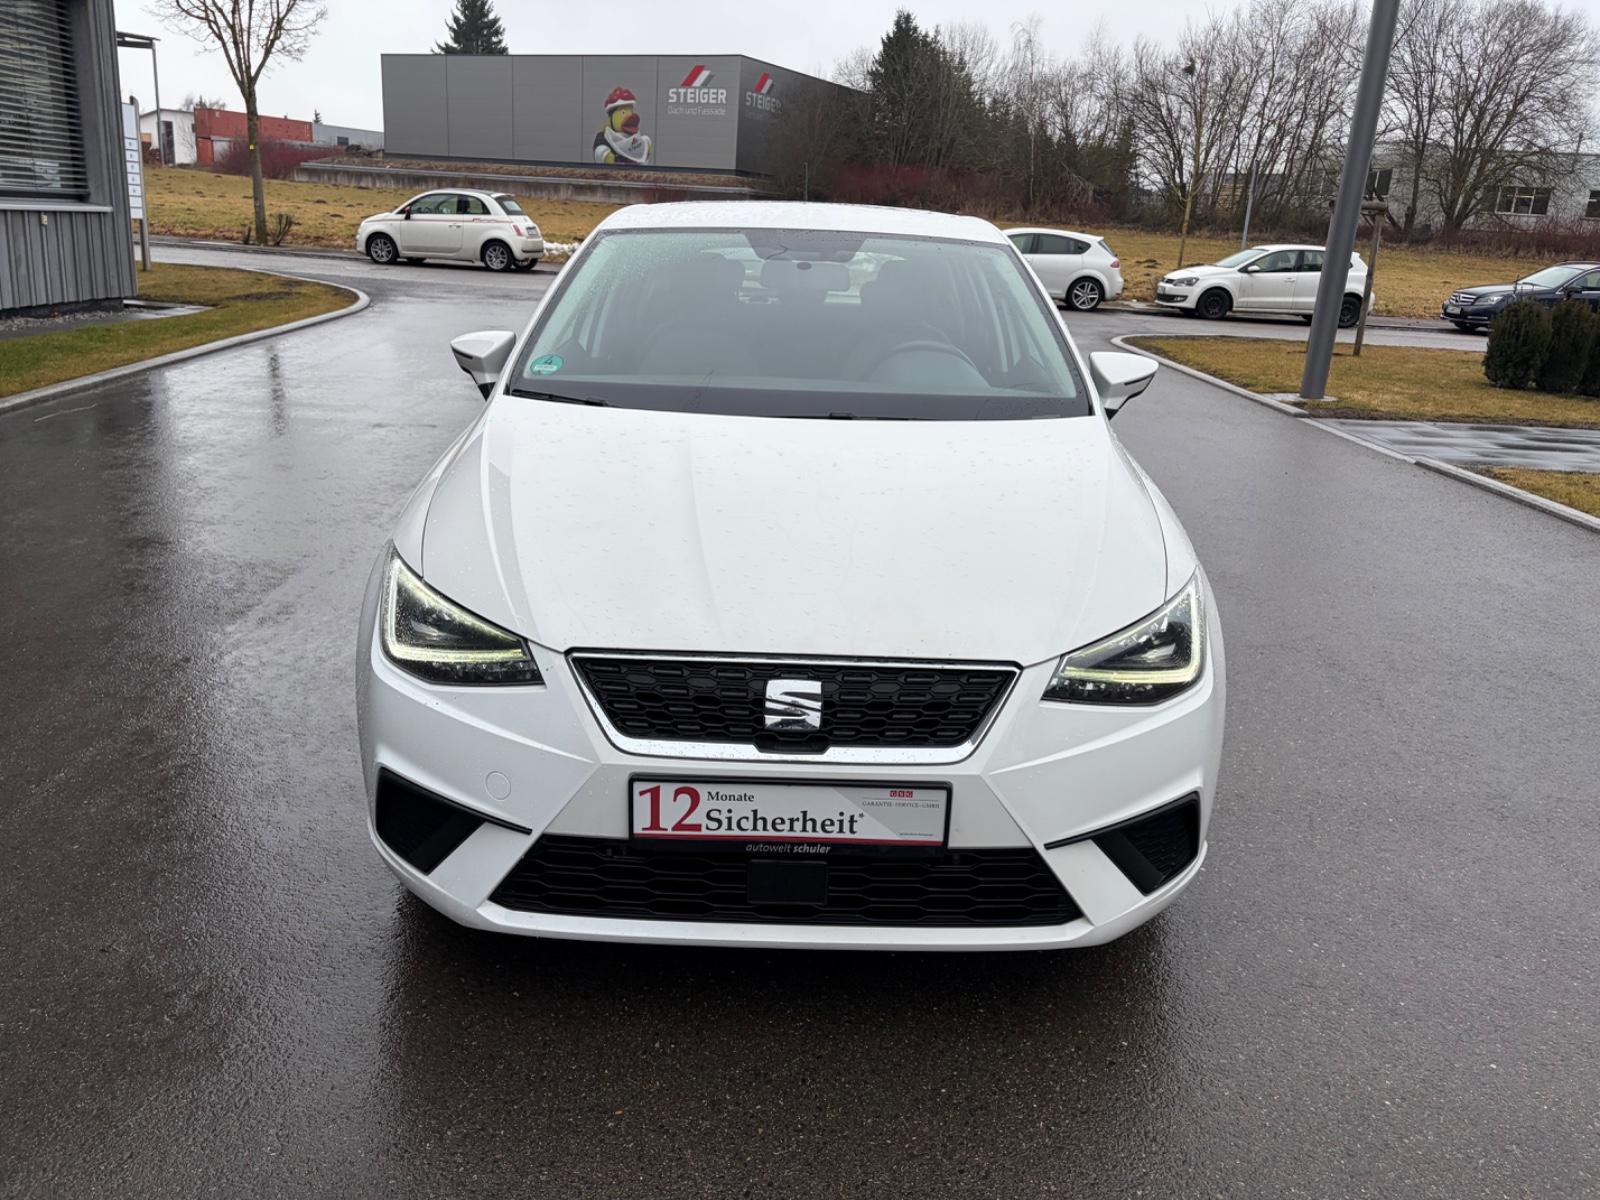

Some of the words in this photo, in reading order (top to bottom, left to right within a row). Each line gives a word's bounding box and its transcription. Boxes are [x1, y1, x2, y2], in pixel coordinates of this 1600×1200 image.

[668, 88, 727, 103] STEIGER
[706, 791, 755, 802] Monate
[639, 784, 702, 832] 12
[745, 842, 791, 853] autowelt
[793, 843, 831, 854] schuler
